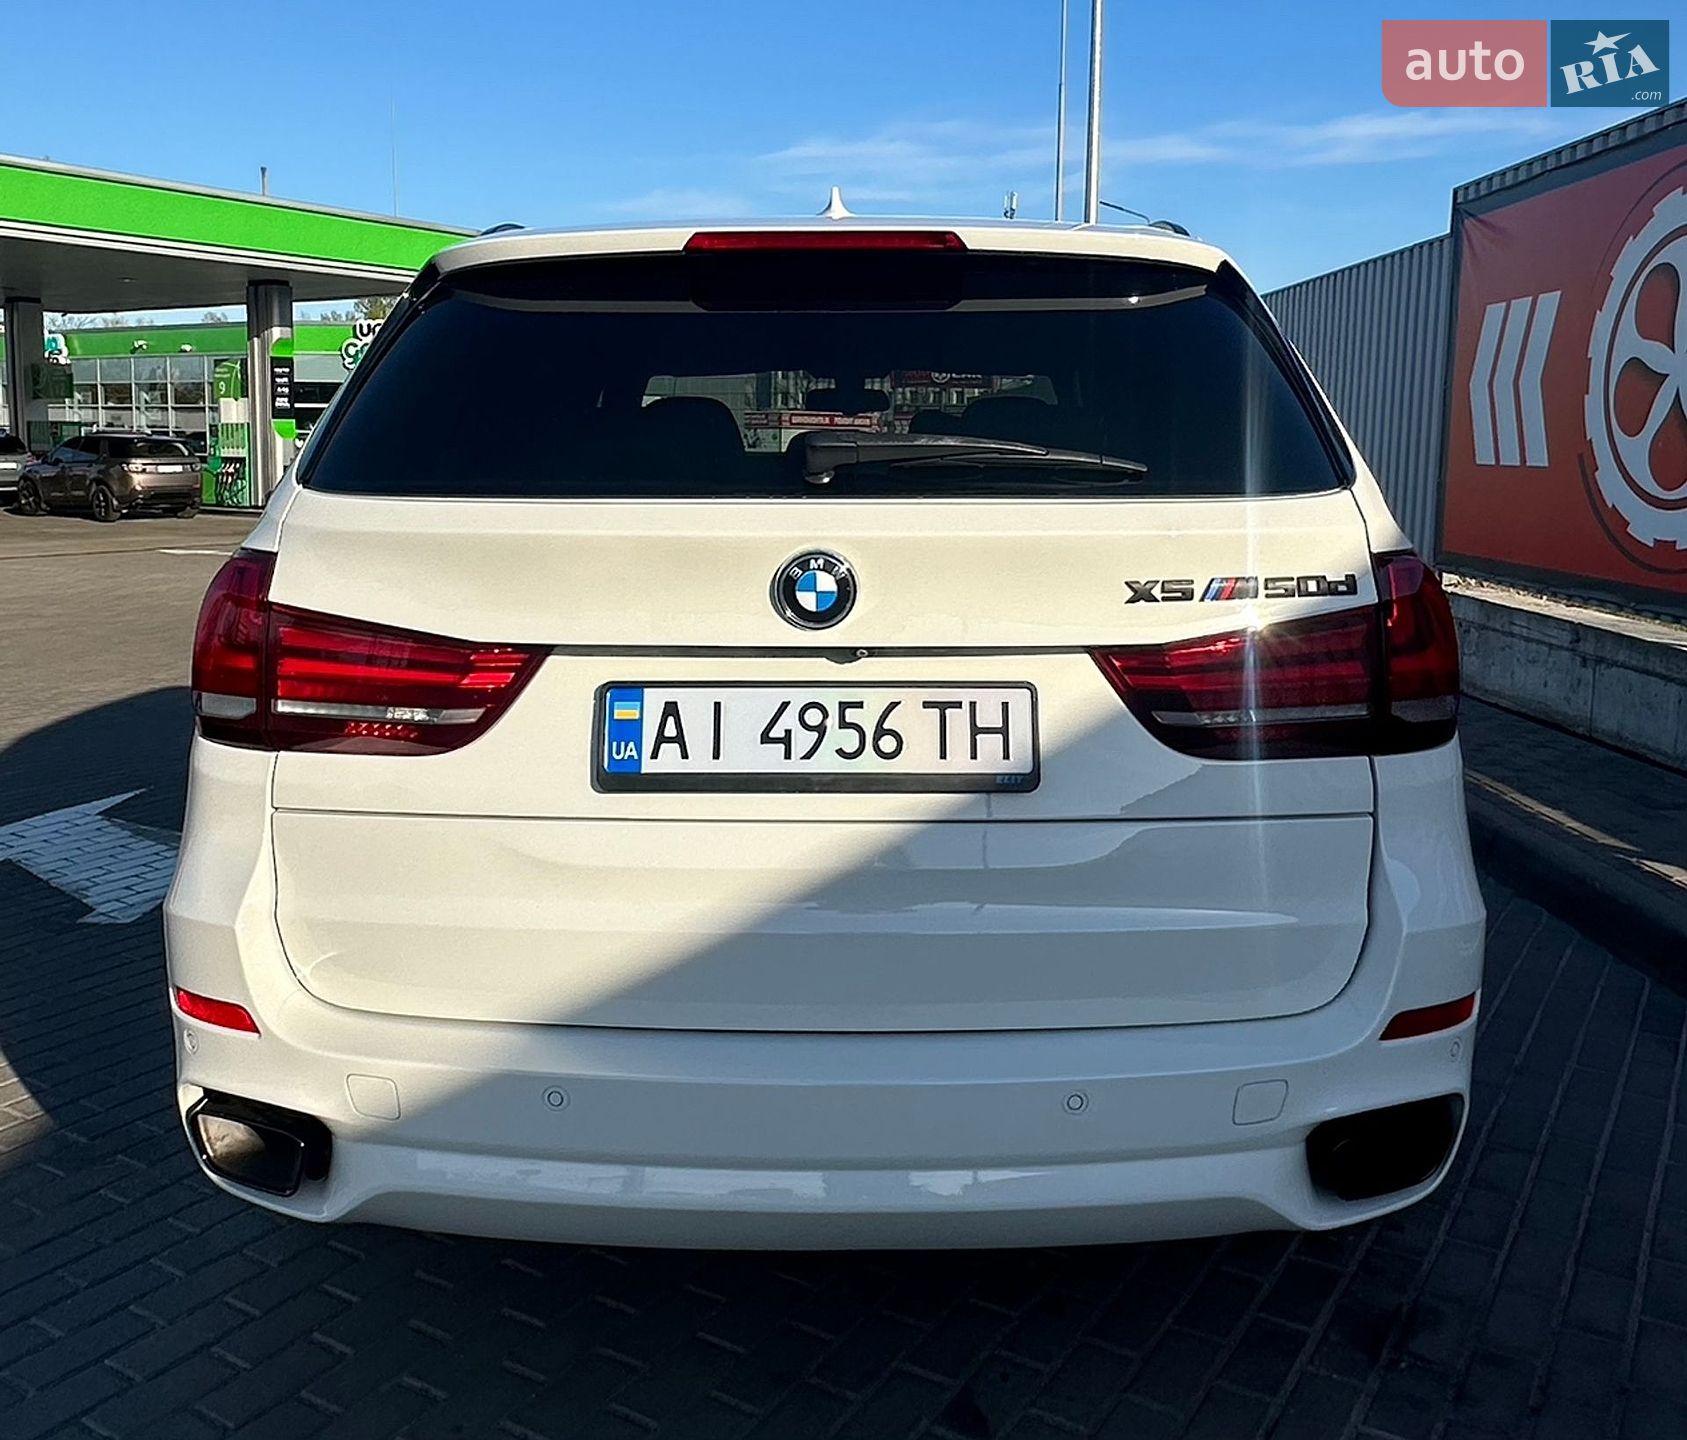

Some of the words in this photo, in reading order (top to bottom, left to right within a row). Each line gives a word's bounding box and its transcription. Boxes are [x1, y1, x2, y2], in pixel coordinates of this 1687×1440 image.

[218, 381, 226, 395] 9
[789, 558, 847, 580] BMW
[1124, 579, 1194, 604] X5
[650, 701, 721, 760] AI
[760, 700, 904, 760] 4956
[922, 700, 1010, 760] TH
[612, 741, 638, 760] UA
